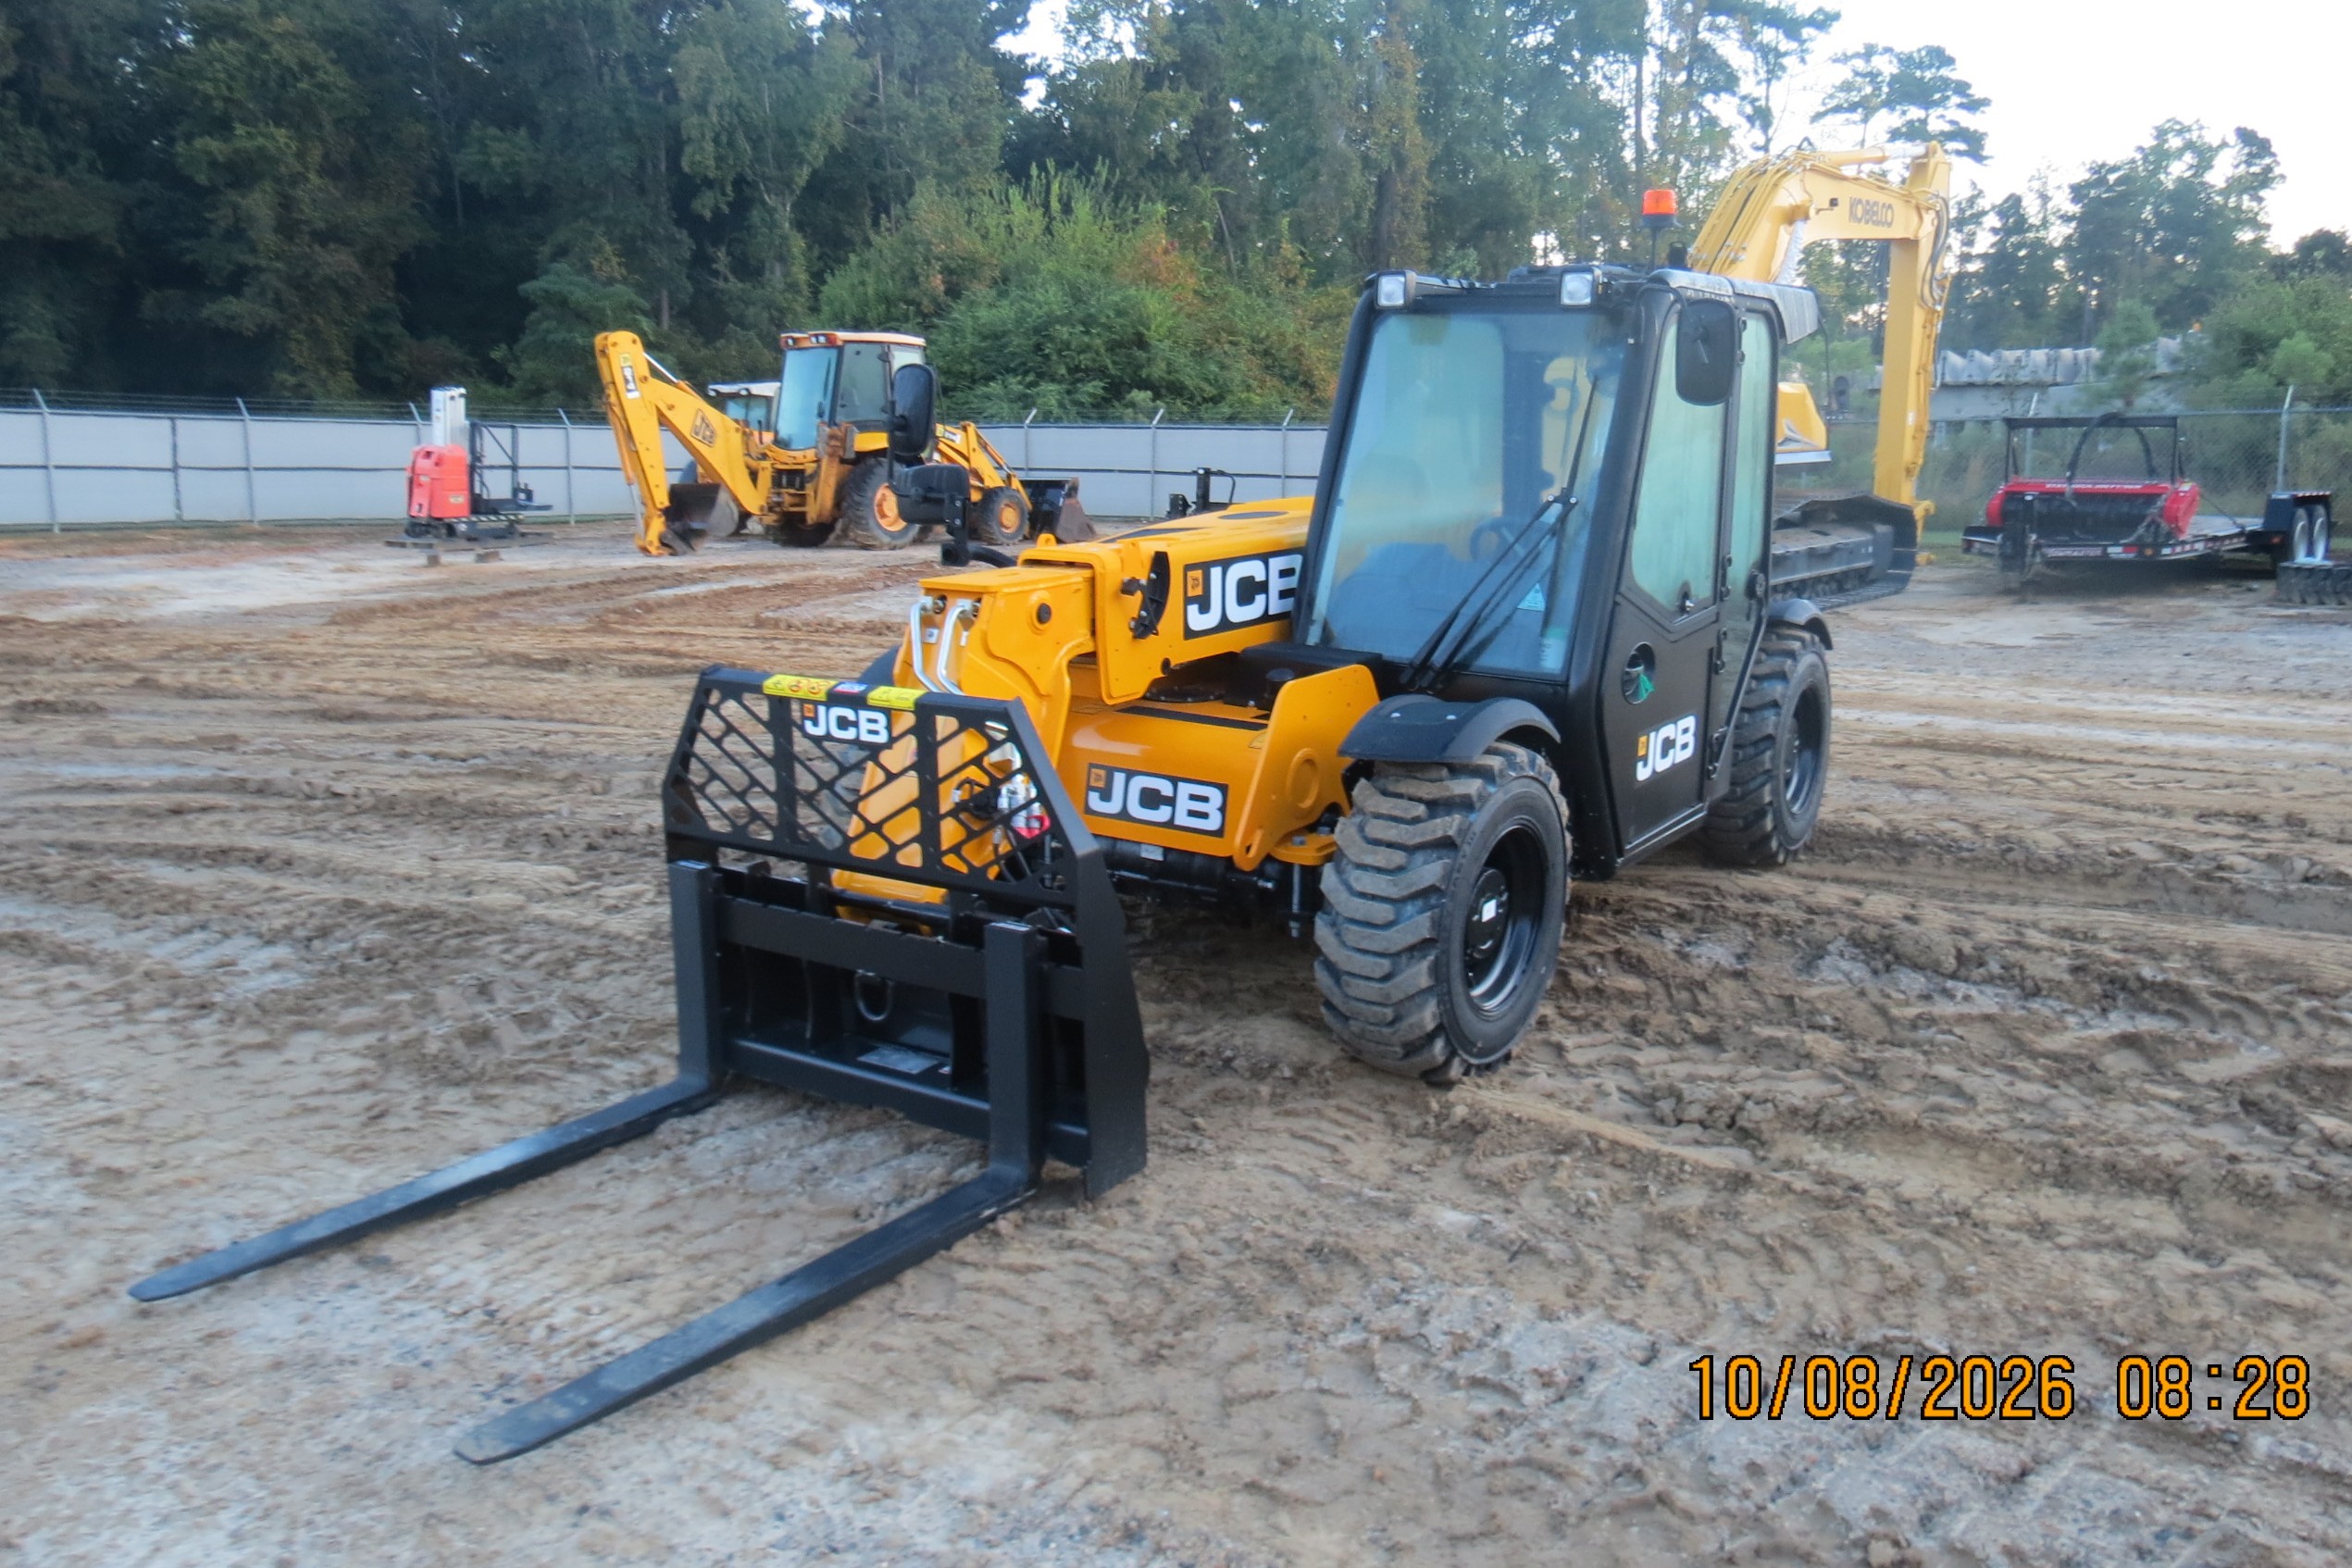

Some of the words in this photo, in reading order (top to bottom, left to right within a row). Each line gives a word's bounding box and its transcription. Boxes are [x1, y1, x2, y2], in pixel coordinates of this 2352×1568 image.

[1848, 196, 1895, 228] KOBELCO
[692, 412, 715, 445] JCB
[1187, 554, 1303, 631] JCB
[803, 704, 889, 743] JCB
[1636, 715, 1697, 781] JCB
[1088, 771, 1223, 831] JCB
